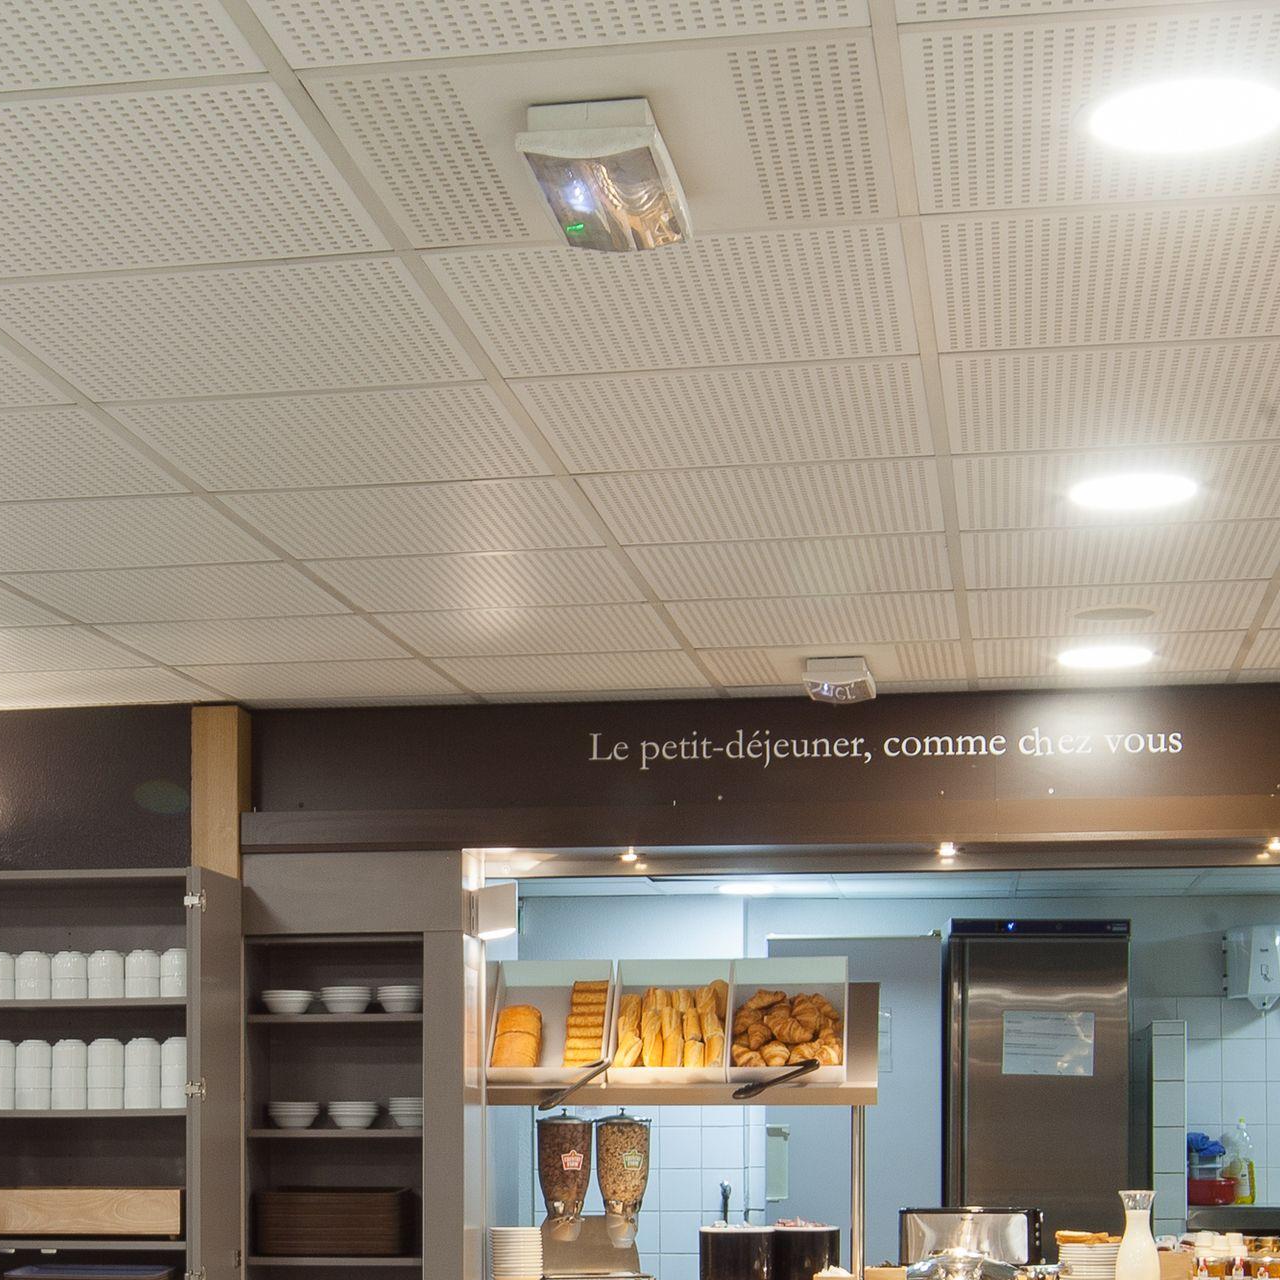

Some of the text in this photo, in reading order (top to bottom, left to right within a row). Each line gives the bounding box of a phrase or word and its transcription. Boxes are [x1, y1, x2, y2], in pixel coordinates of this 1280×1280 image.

[589, 727, 1184, 770] Le petit-déjeuner, comme chez vous
